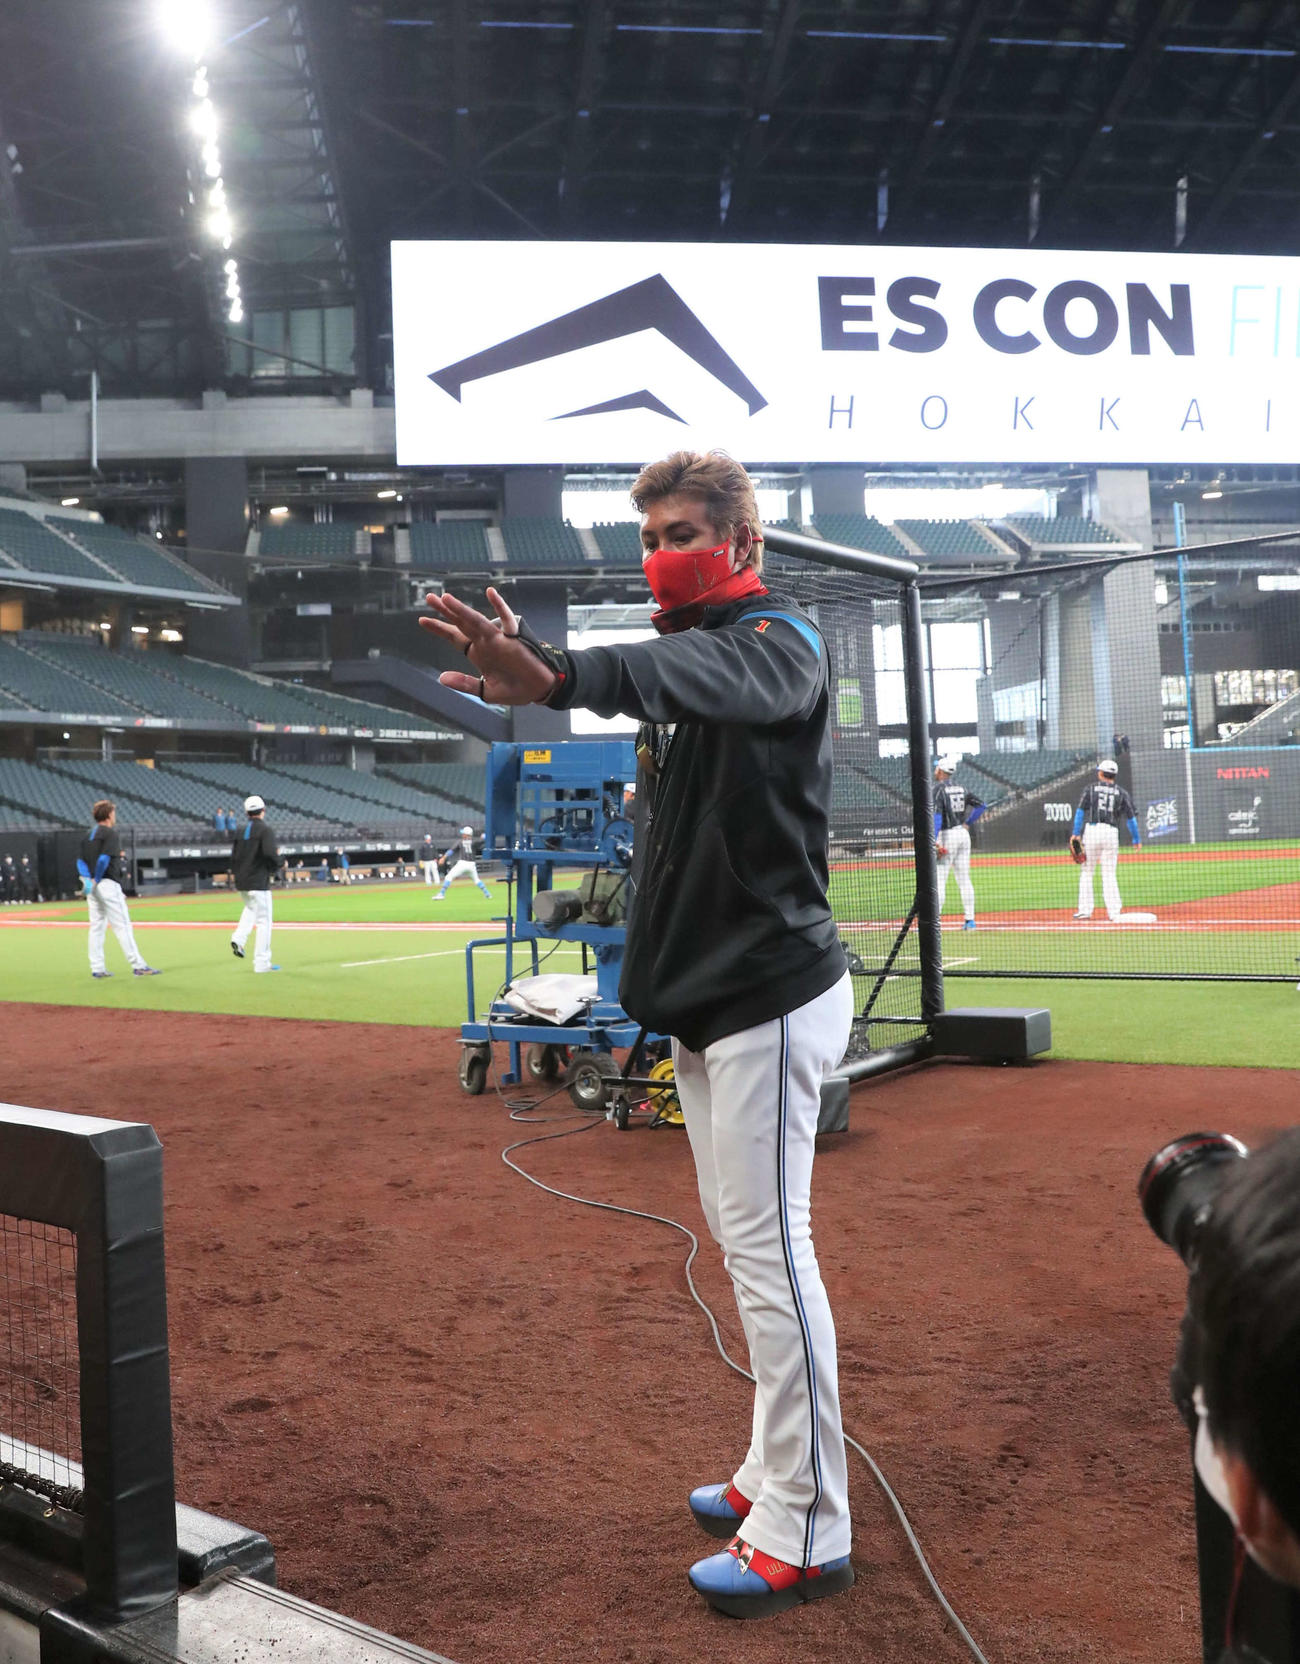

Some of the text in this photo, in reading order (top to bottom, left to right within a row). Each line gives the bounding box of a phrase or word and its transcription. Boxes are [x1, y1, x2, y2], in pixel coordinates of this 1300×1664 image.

[817, 276, 948, 353] ES
[973, 278, 1195, 356] CON
[828, 394, 1271, 432] HOKKAI
[1216, 766, 1271, 780] NITTAN
[1097, 792, 1115, 812] 21
[1146, 799, 1177, 820] ASK
[1043, 803, 1073, 822] TOTO
[1145, 814, 1178, 831] GATE
